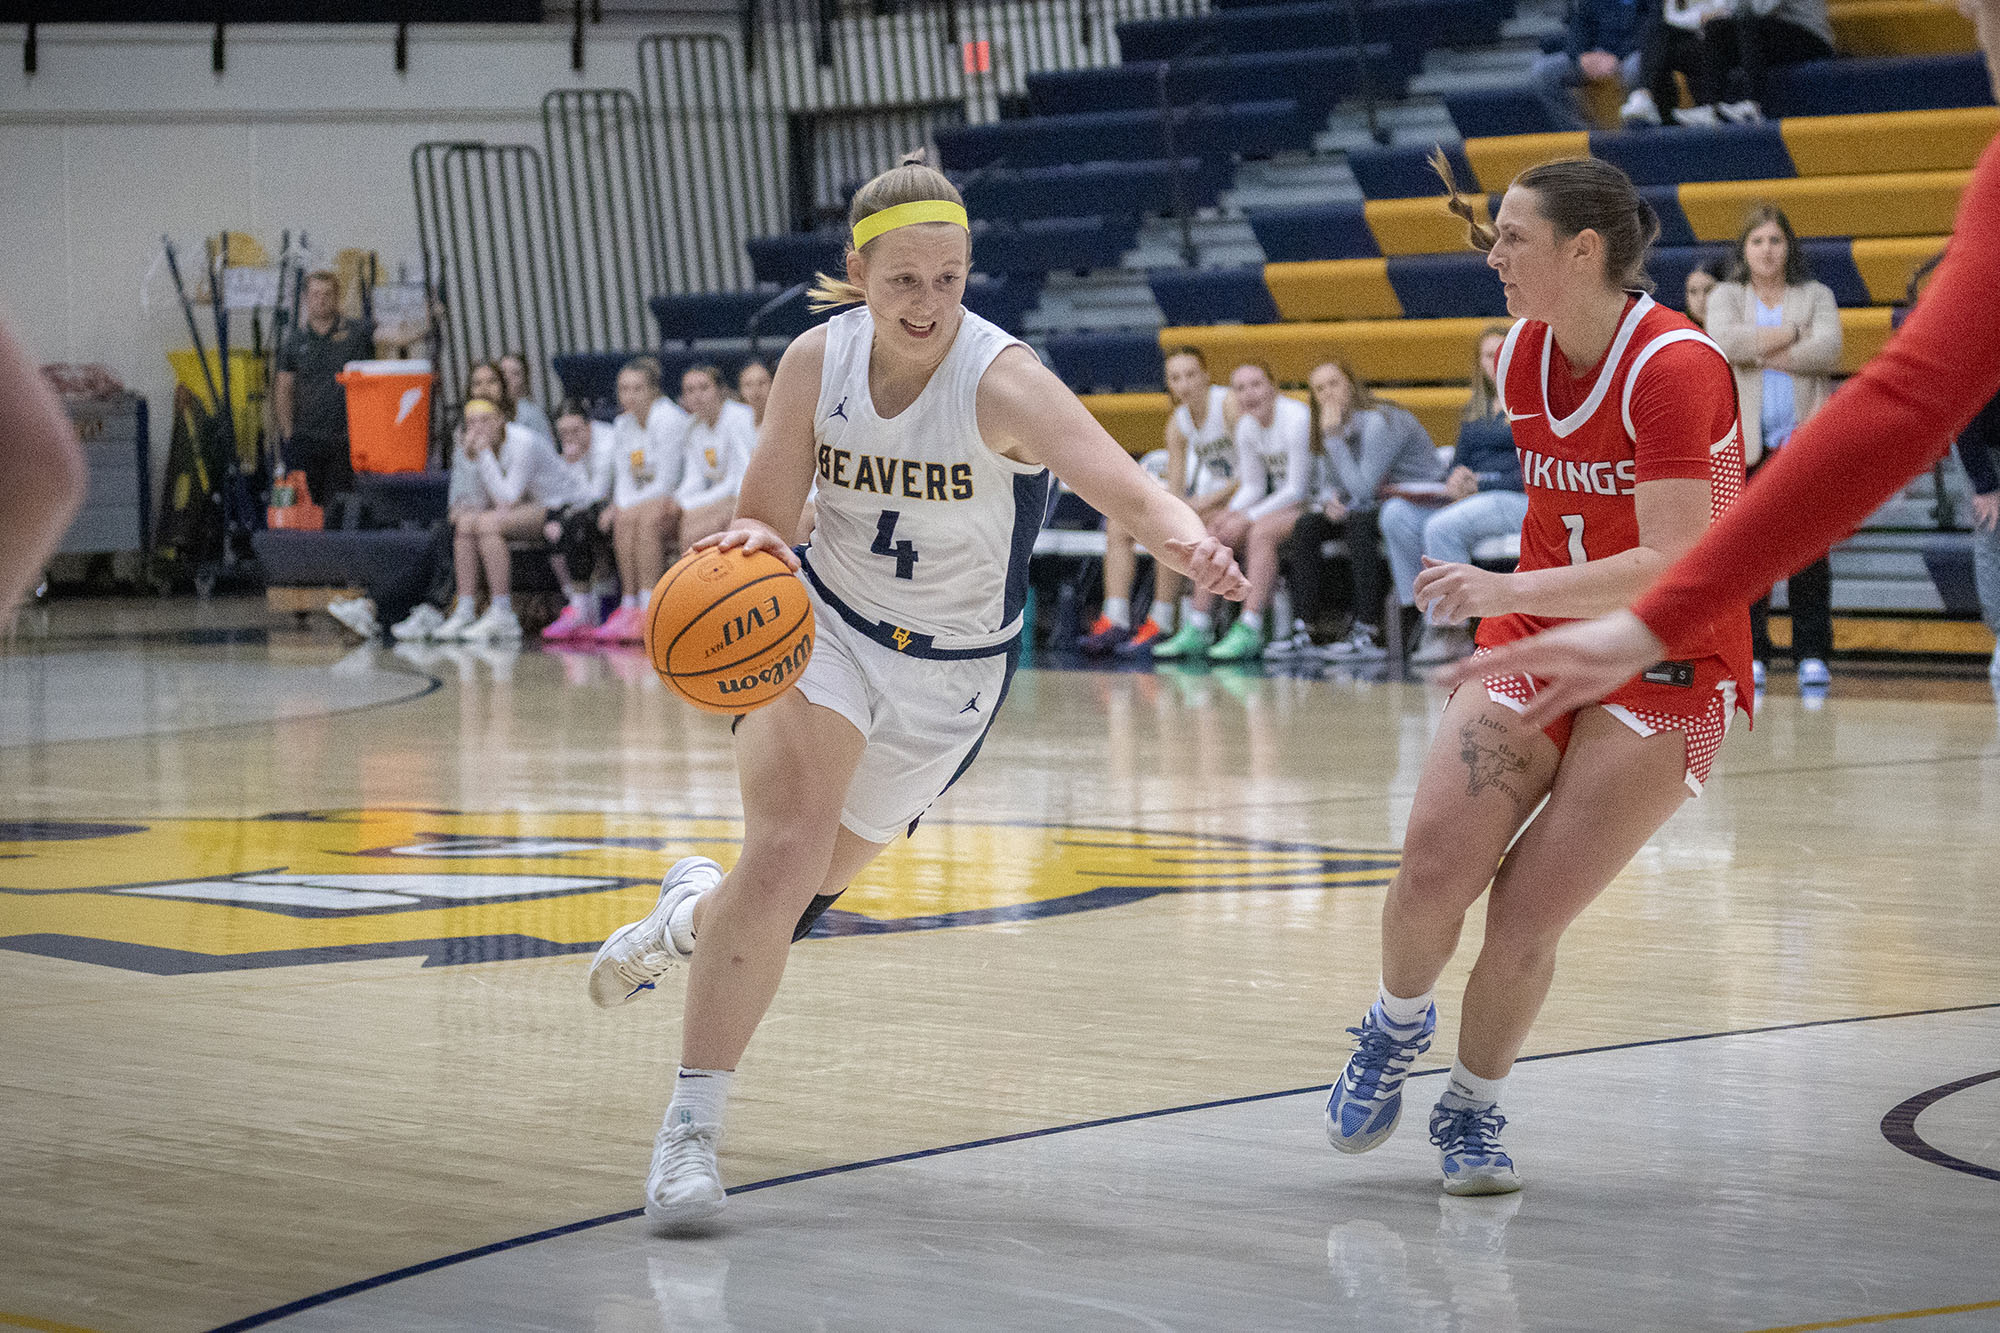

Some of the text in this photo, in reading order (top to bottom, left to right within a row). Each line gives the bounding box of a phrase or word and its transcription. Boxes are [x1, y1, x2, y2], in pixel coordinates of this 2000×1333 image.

[818, 443, 974, 501] BEAVERS
[870, 509, 919, 580] 4
[1560, 513, 1588, 566] 1
[716, 633, 812, 695] Wilson
[1679, 670, 1687, 680] S
